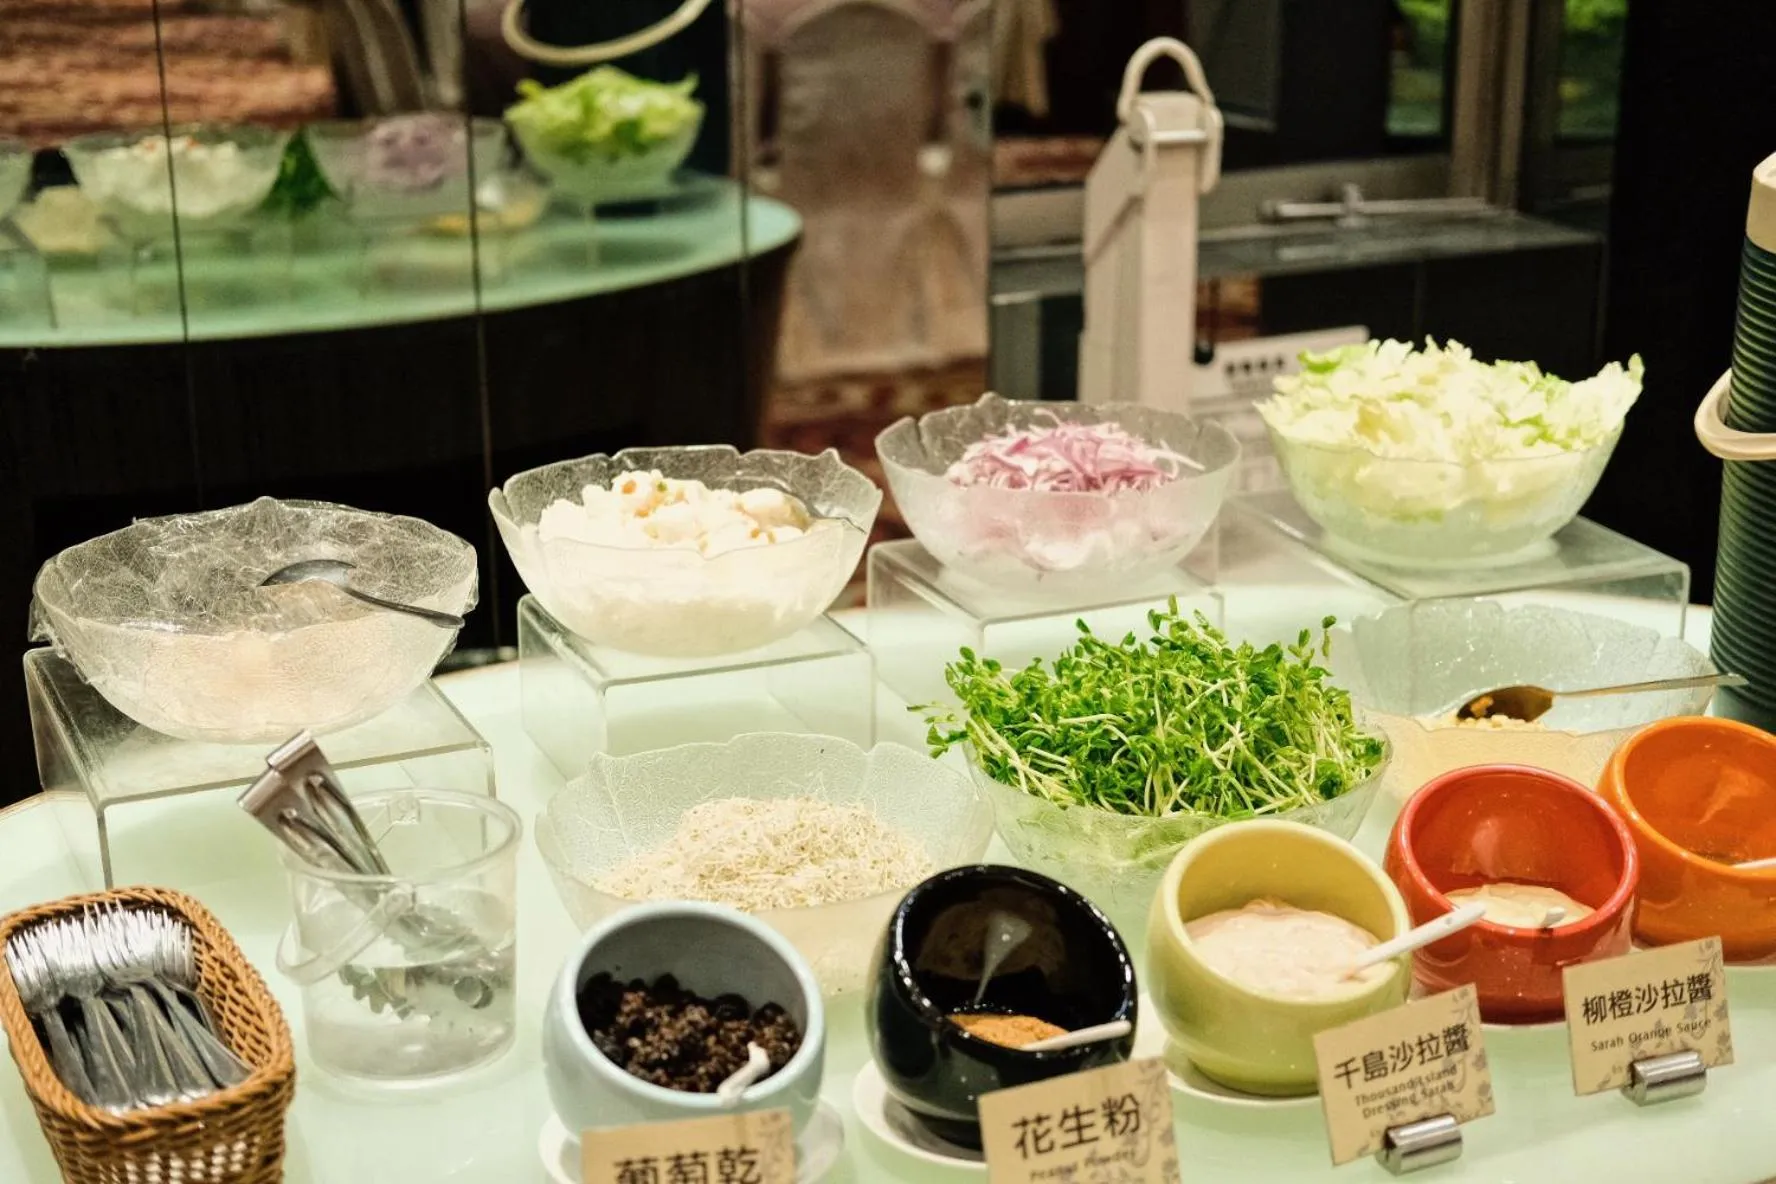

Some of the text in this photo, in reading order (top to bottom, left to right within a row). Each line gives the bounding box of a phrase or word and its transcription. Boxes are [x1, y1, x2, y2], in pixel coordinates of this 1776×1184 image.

[1582, 972, 1712, 1025] 柳橙沙拉醬
[1333, 1022, 1470, 1089] 千島沙拉醬
[1590, 1035, 1624, 1052] Sarah
[1676, 1018, 1712, 1036] Sauce
[1011, 1093, 1141, 1160] 花生粉
[613, 1145, 762, 1184] 葡萄乾
